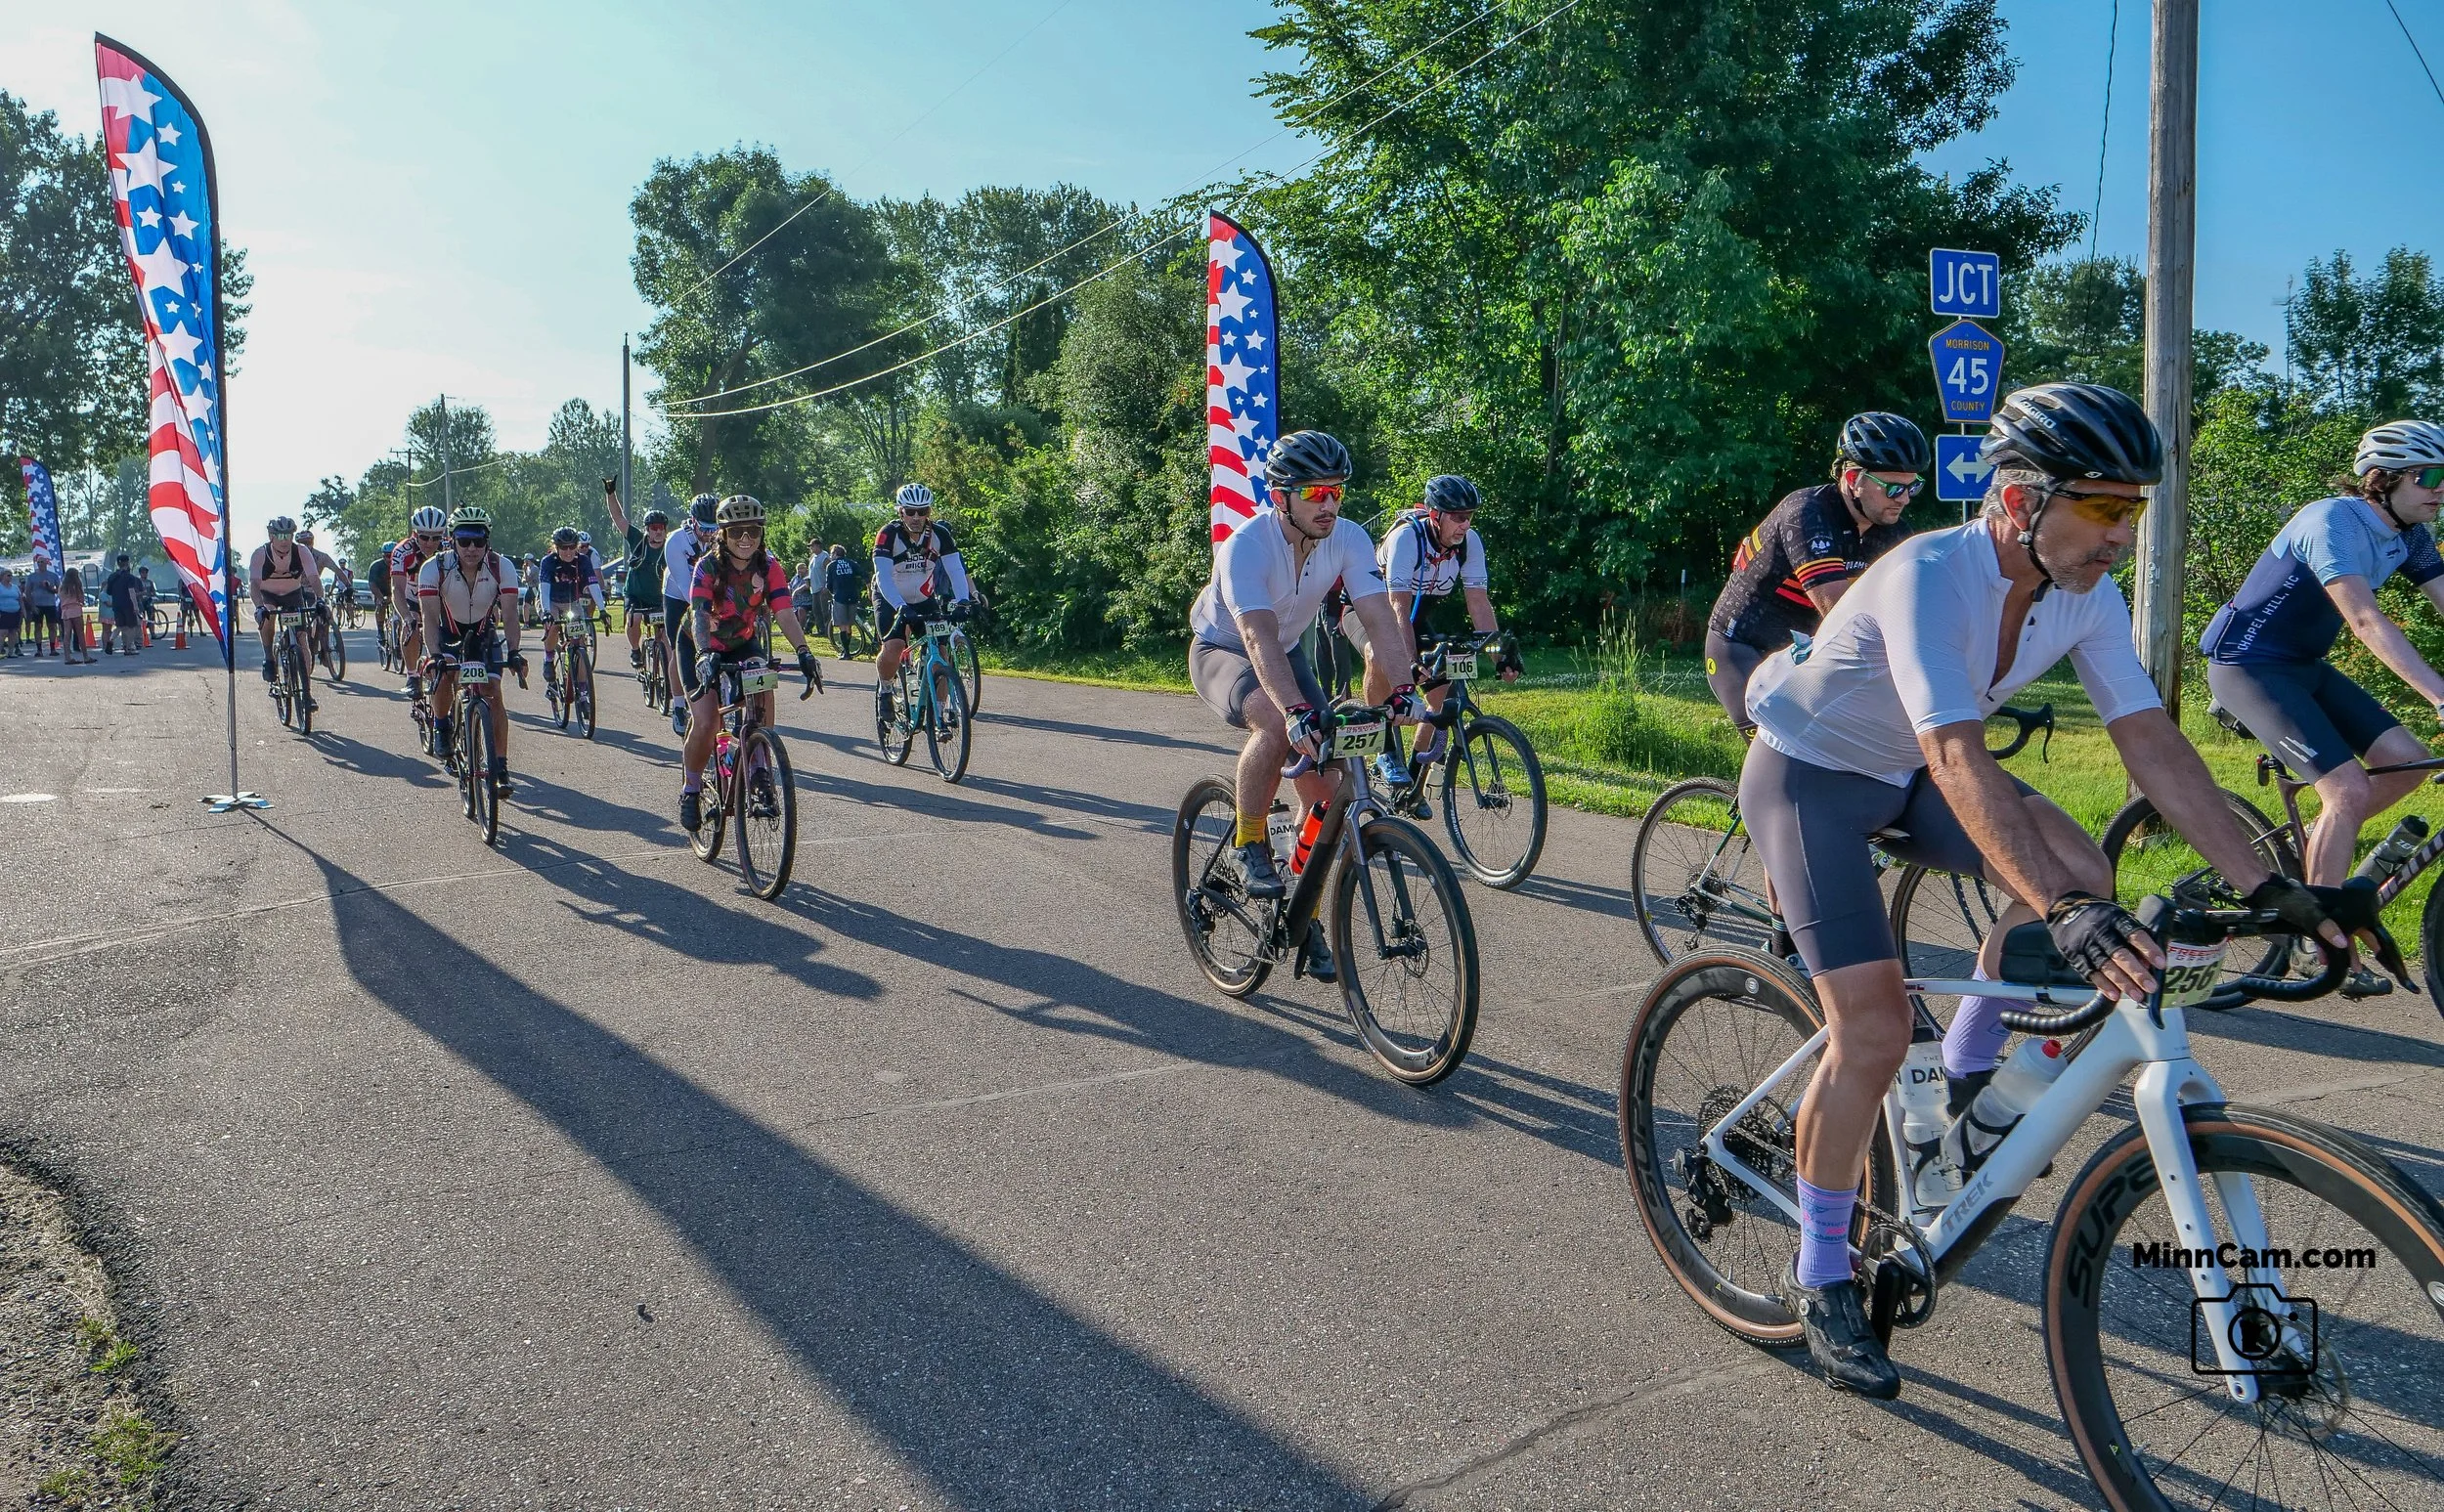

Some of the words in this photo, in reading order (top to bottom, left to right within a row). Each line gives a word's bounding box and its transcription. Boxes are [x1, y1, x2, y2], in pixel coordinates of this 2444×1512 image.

[1938, 261, 1993, 306] JCT
[1945, 338, 1989, 351] MORRISON
[1946, 357, 1989, 395] 45
[1950, 400, 1986, 411] COUNTY
[392, 539, 414, 566] VELO
[2237, 618, 2267, 651] CHAPEL
[2261, 592, 2290, 616] HILL,
[2283, 575, 2299, 589] NC
[570, 625, 584, 633] 228
[929, 623, 945, 633] 189
[463, 668, 485, 677] 208
[1452, 661, 1473, 673] 106
[756, 675, 764, 686] 4
[1342, 731, 1379, 751] 257
[2164, 960, 2219, 994] 256
[1942, 1171, 1994, 1233] TREK
[2067, 1147, 2161, 1310] SUPE
